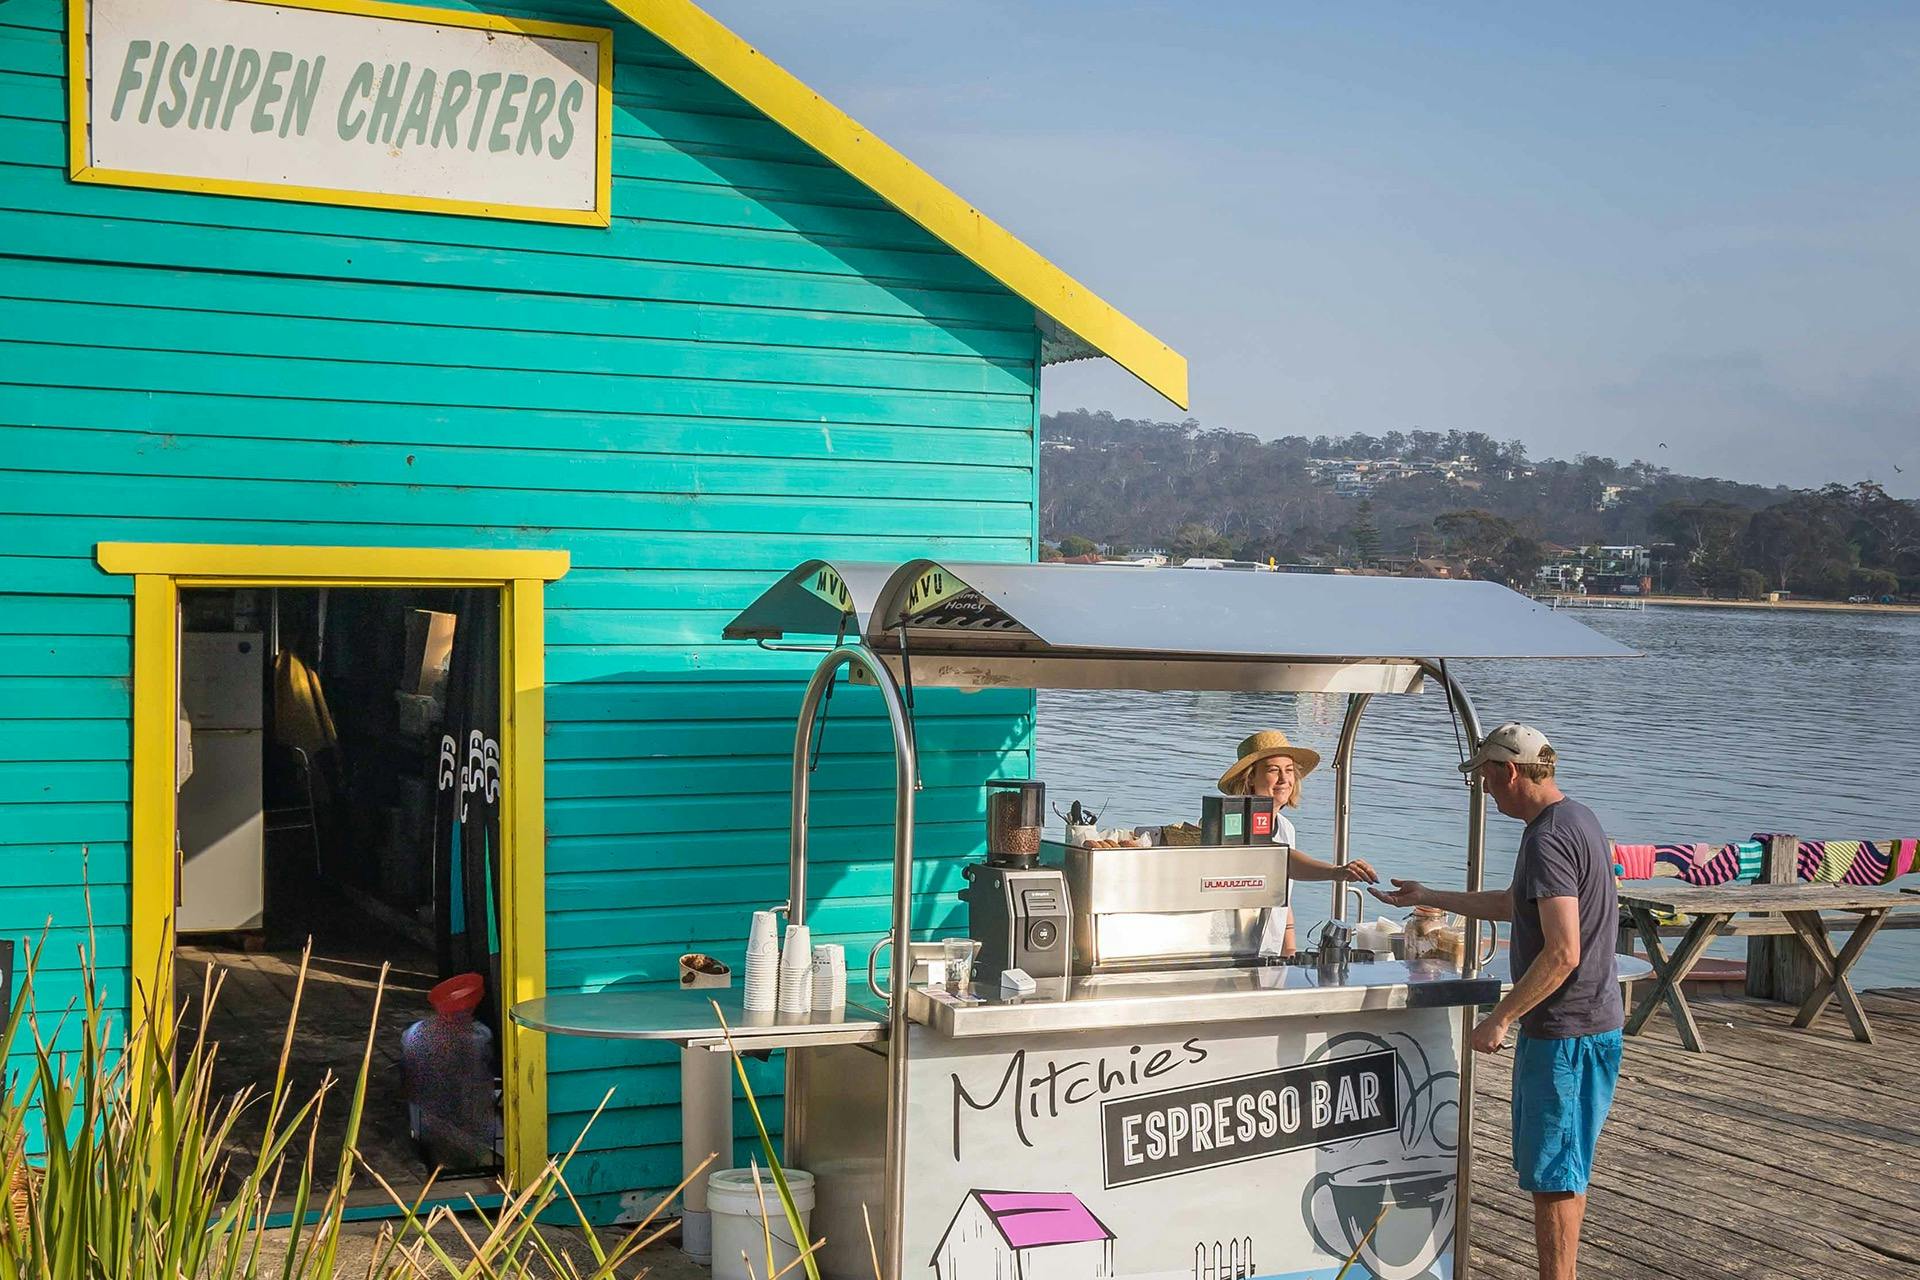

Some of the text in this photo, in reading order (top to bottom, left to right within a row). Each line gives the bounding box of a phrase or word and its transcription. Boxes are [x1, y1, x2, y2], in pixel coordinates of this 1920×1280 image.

[111, 40, 584, 160] FISHPEN CHARTERS
[944, 600, 986, 613] Honey
[1256, 815, 1268, 826] T2
[951, 1037, 1208, 1162] Mitchies
[1121, 1071, 1381, 1167] ESPRESSO BAR
